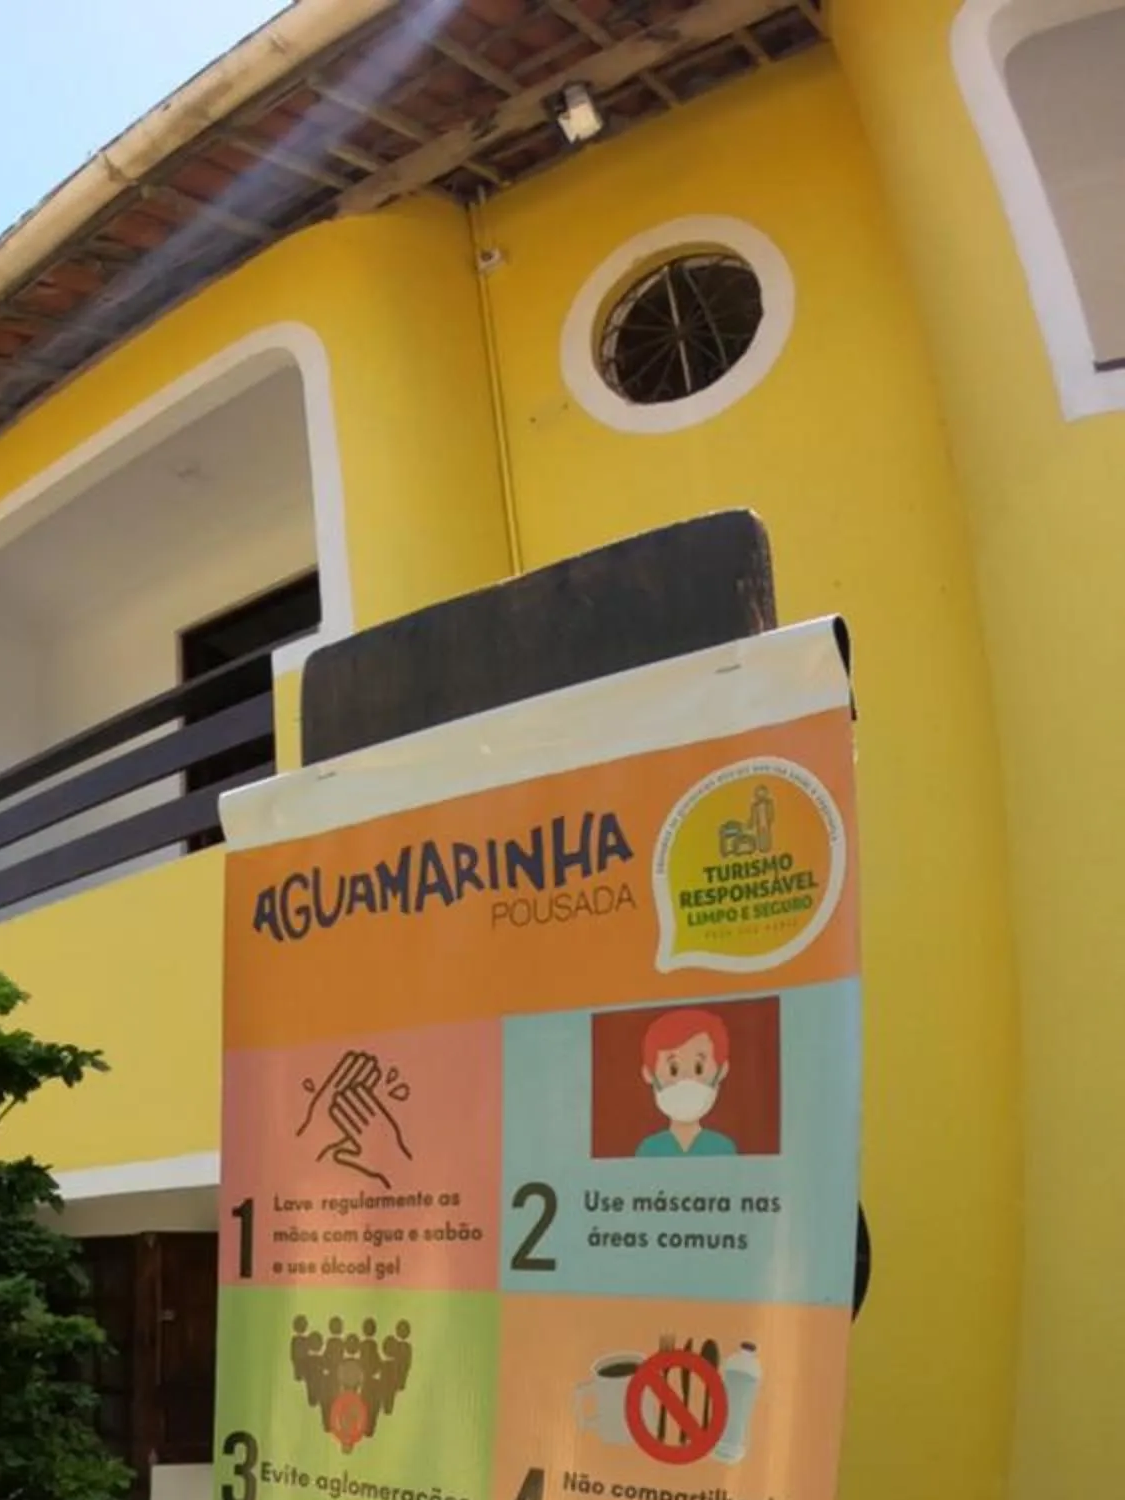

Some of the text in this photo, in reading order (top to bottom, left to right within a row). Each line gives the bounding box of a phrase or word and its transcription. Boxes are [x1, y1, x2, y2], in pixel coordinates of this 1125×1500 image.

[253, 811, 634, 942] AGUAMARINHA
[703, 853, 793, 884] TURISMO
[679, 870, 818, 909] RESPONSÁVEL
[491, 883, 637, 929] POUSADA
[687, 895, 813, 928] LIMPO E SEGURO
[273, 1190, 461, 1215] Lave regularmente as
[584, 1190, 782, 1214] Use máscara nas
[231, 1197, 254, 1279] 1
[273, 1221, 483, 1247] mãos com água e sabão
[510, 1181, 558, 1272] 2
[588, 1225, 748, 1250] áreas comuns
[272, 1255, 401, 1280] e use álcool gel
[260, 1461, 310, 1488] Evite
[563, 1471, 604, 1496] Não
